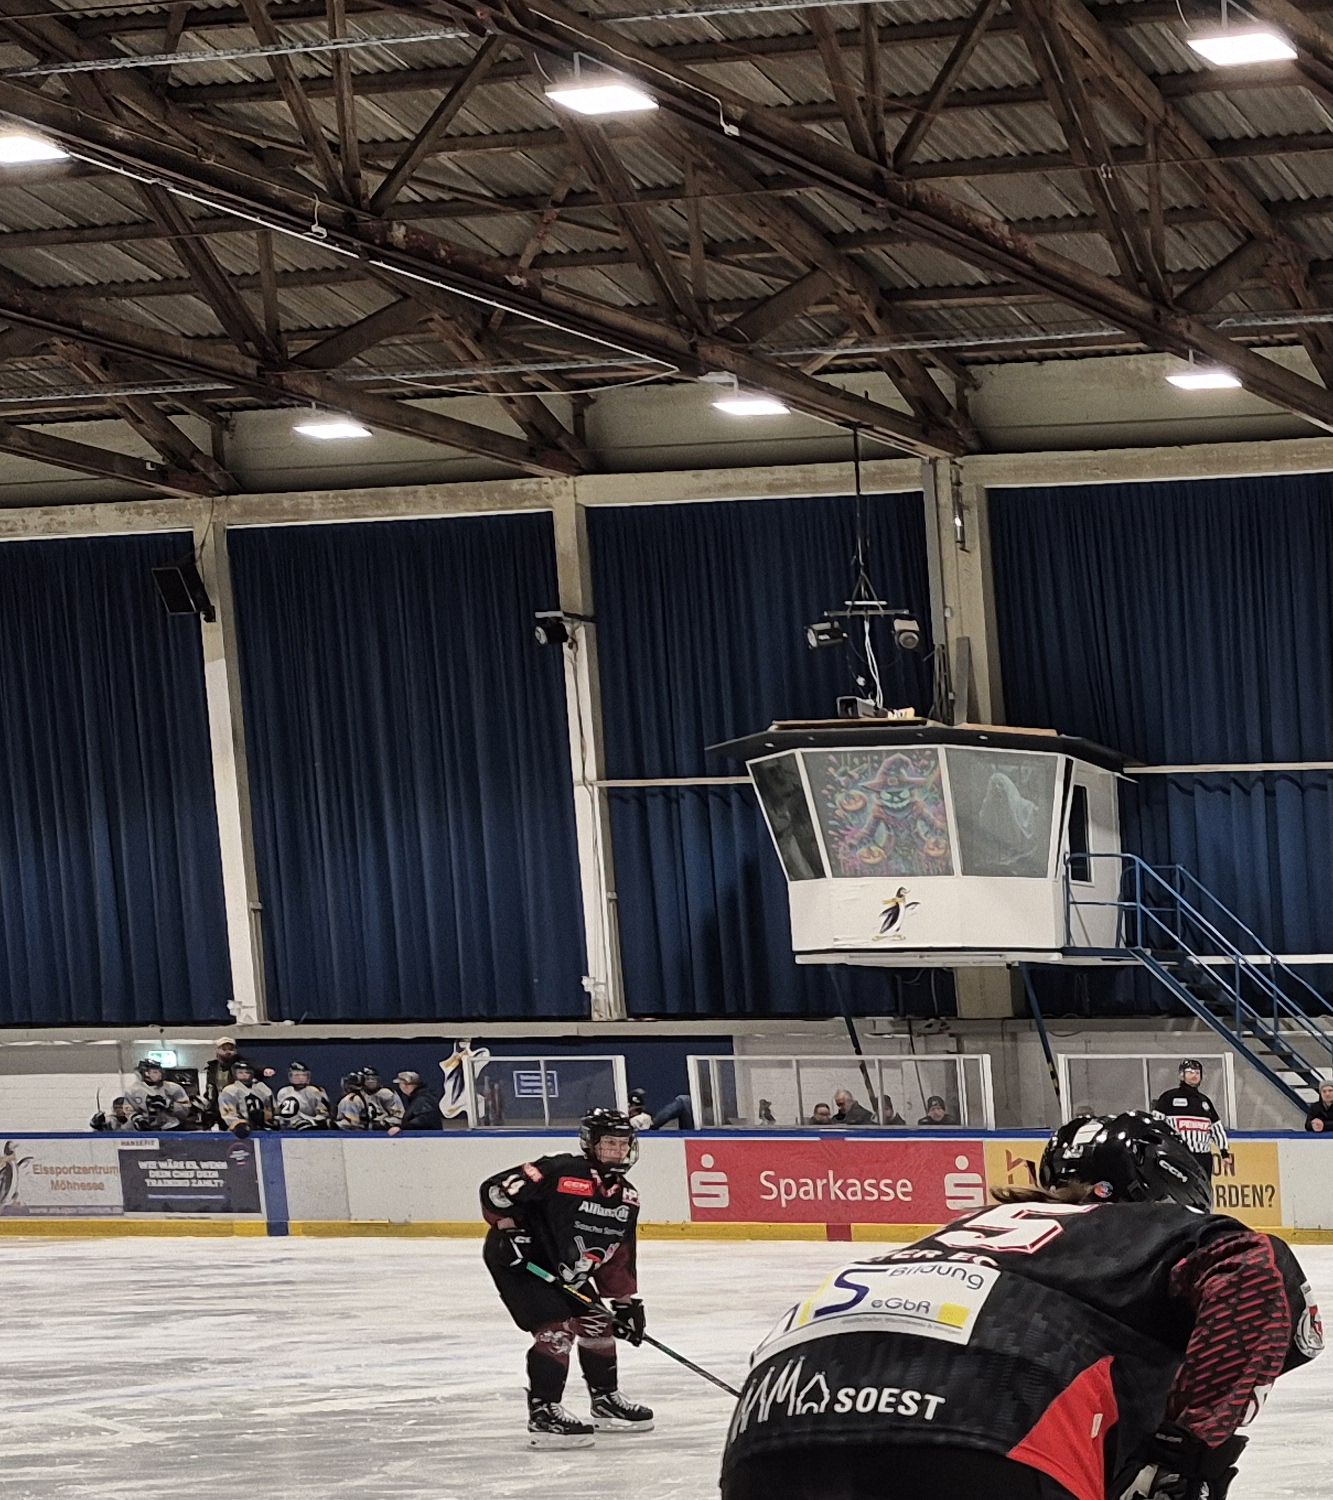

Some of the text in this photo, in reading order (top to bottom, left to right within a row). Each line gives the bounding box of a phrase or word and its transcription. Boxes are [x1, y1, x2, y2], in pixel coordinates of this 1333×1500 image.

[33, 1164, 119, 1176] Eissportzentrum
[1158, 1159, 1189, 1184] CCM
[759, 1170, 914, 1208] Sparkasse
[833, 1387, 946, 1421] SOEST
